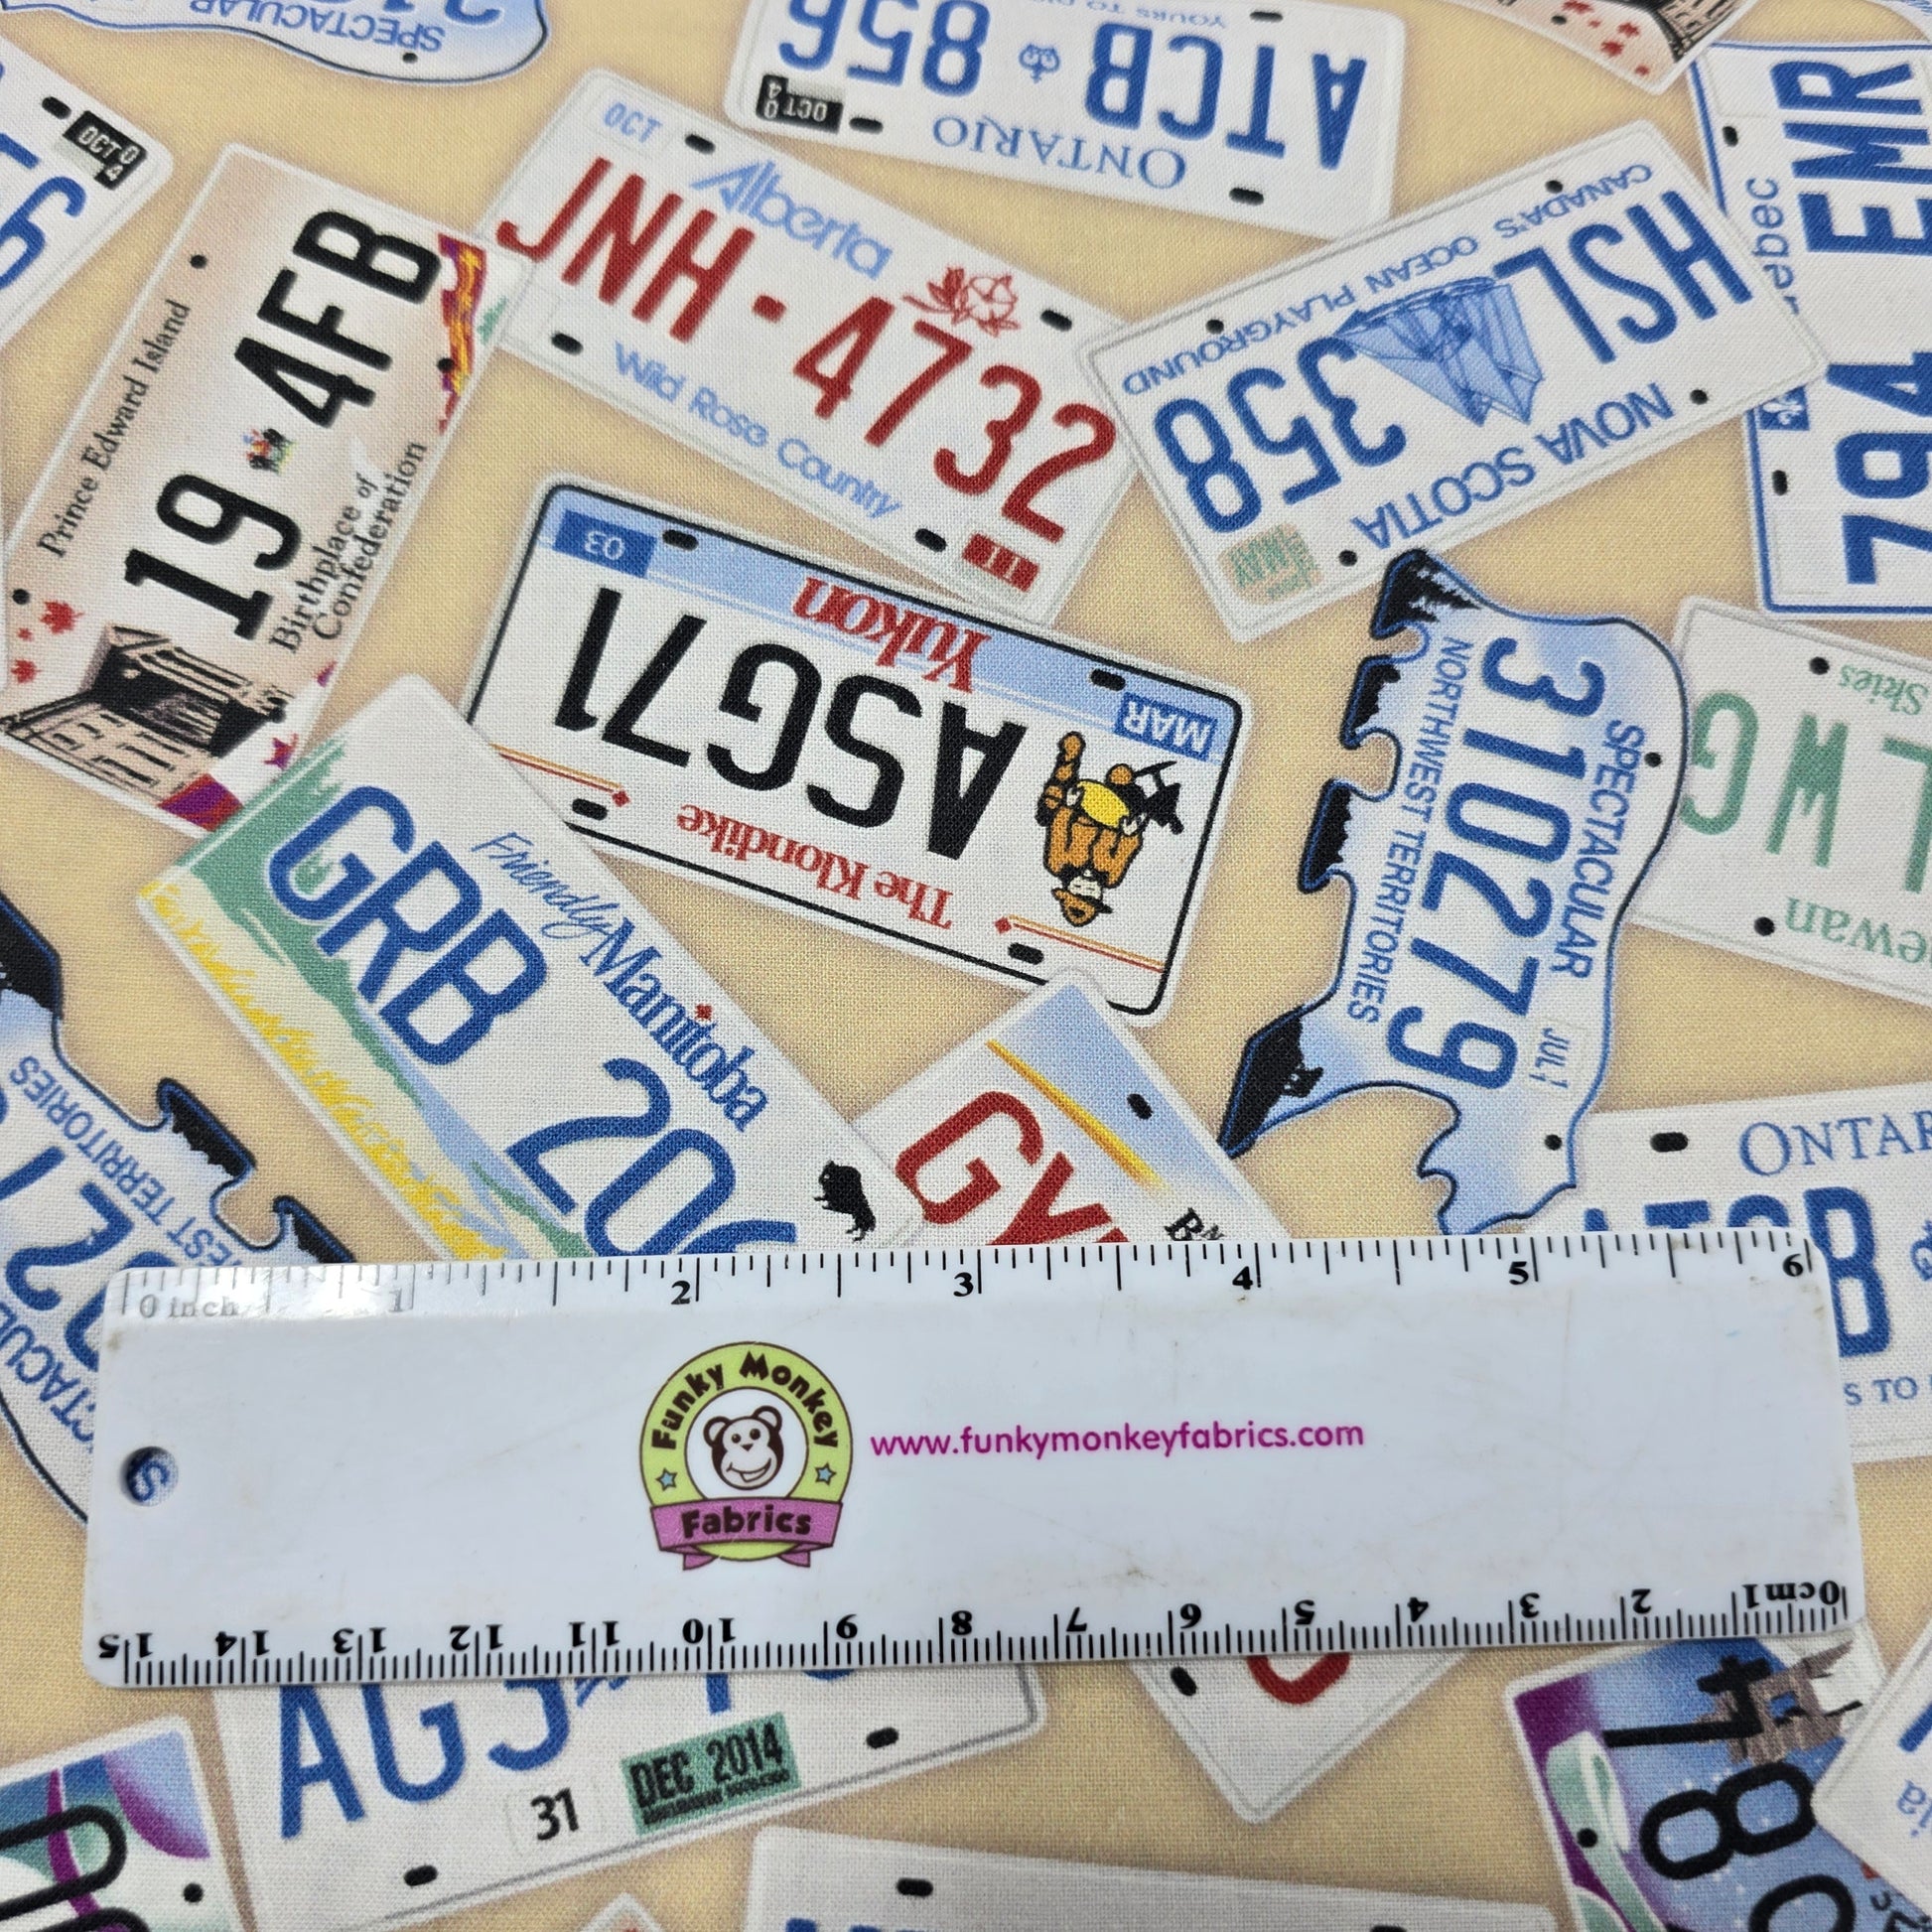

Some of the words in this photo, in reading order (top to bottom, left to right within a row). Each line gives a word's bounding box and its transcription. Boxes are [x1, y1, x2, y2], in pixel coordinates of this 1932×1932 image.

[778, 0, 991, 97] 856
[603, 100, 663, 144] OCT
[782, 97, 828, 122] OCT
[1084, 21, 1367, 171] ATCB
[77, 125, 122, 161] OCT
[931, 113, 1188, 190] ONTARIO
[1769, 61, 1932, 256] EMR
[688, 158, 895, 282] Alberta
[1493, 162, 1653, 242] CANADA'S
[1366, 234, 1479, 295] OCEAN
[1491, 189, 1754, 366] HSL
[496, 156, 756, 345] JNH
[791, 295, 1118, 544] 4732
[1122, 283, 1356, 397] PLAYGROUND
[37, 477, 97, 559] Prince
[81, 375, 149, 474] Edward
[133, 298, 192, 374] Island
[124, 474, 302, 641] 19
[233, 209, 443, 429] 4FB
[613, 340, 687, 402] Wild
[688, 386, 769, 453] Rose
[775, 435, 904, 520] Country
[1152, 335, 1408, 534] 358
[1535, 380, 1676, 466] NOVA
[312, 441, 428, 640] Confederation
[1350, 443, 1538, 551] SCOTIA
[268, 506, 362, 654] Birthplace
[357, 473, 379, 499] of
[583, 528, 625, 562] 03
[788, 576, 993, 694] Yukon
[553, 586, 1030, 862] ASG71
[1121, 698, 1217, 759] MAR
[1400, 635, 1474, 826] NORTHWEST
[1839, 663, 1930, 717] Skies
[470, 830, 621, 941] Friendly
[675, 802, 878, 901] Klondike
[1385, 636, 1606, 1091] 310279
[1550, 719, 1646, 980] SPECTACULAR
[268, 784, 548, 1066] GRB
[877, 866, 956, 931] The
[1347, 828, 1426, 1024] TERRITORIES
[1785, 897, 1932, 965] ewan
[579, 916, 769, 1134] Manitoba
[1532, 1027, 1571, 1069] JUL
[9, 1054, 177, 1226] TERRITORIES
[169, 1295, 240, 1319] inch
[670, 1281, 693, 1306] 2
[953, 1273, 975, 1297] 3
[1231, 1266, 1254, 1292] 4
[1507, 1261, 1530, 1286] 5
[1782, 1252, 1805, 1279] 6
[650, 1362, 725, 1451] Funky
[739, 1350, 839, 1449] Monkey
[1871, 1375, 1919, 1406] TO
[870, 1421, 1366, 1460] www.funkymonkeyfabrics.com
[680, 1503, 812, 1539] Fabrics
[950, 1609, 973, 1636] 8
[1065, 1606, 1088, 1632] 7
[1294, 1599, 1315, 1626] 5
[1407, 1596, 1430, 1623] 4
[1519, 1591, 1541, 1618] 3
[1630, 1587, 1652, 1615] 2
[628, 1749, 695, 1809] DEC
[705, 1721, 783, 1785] 2014
[530, 1787, 581, 1842] 31
